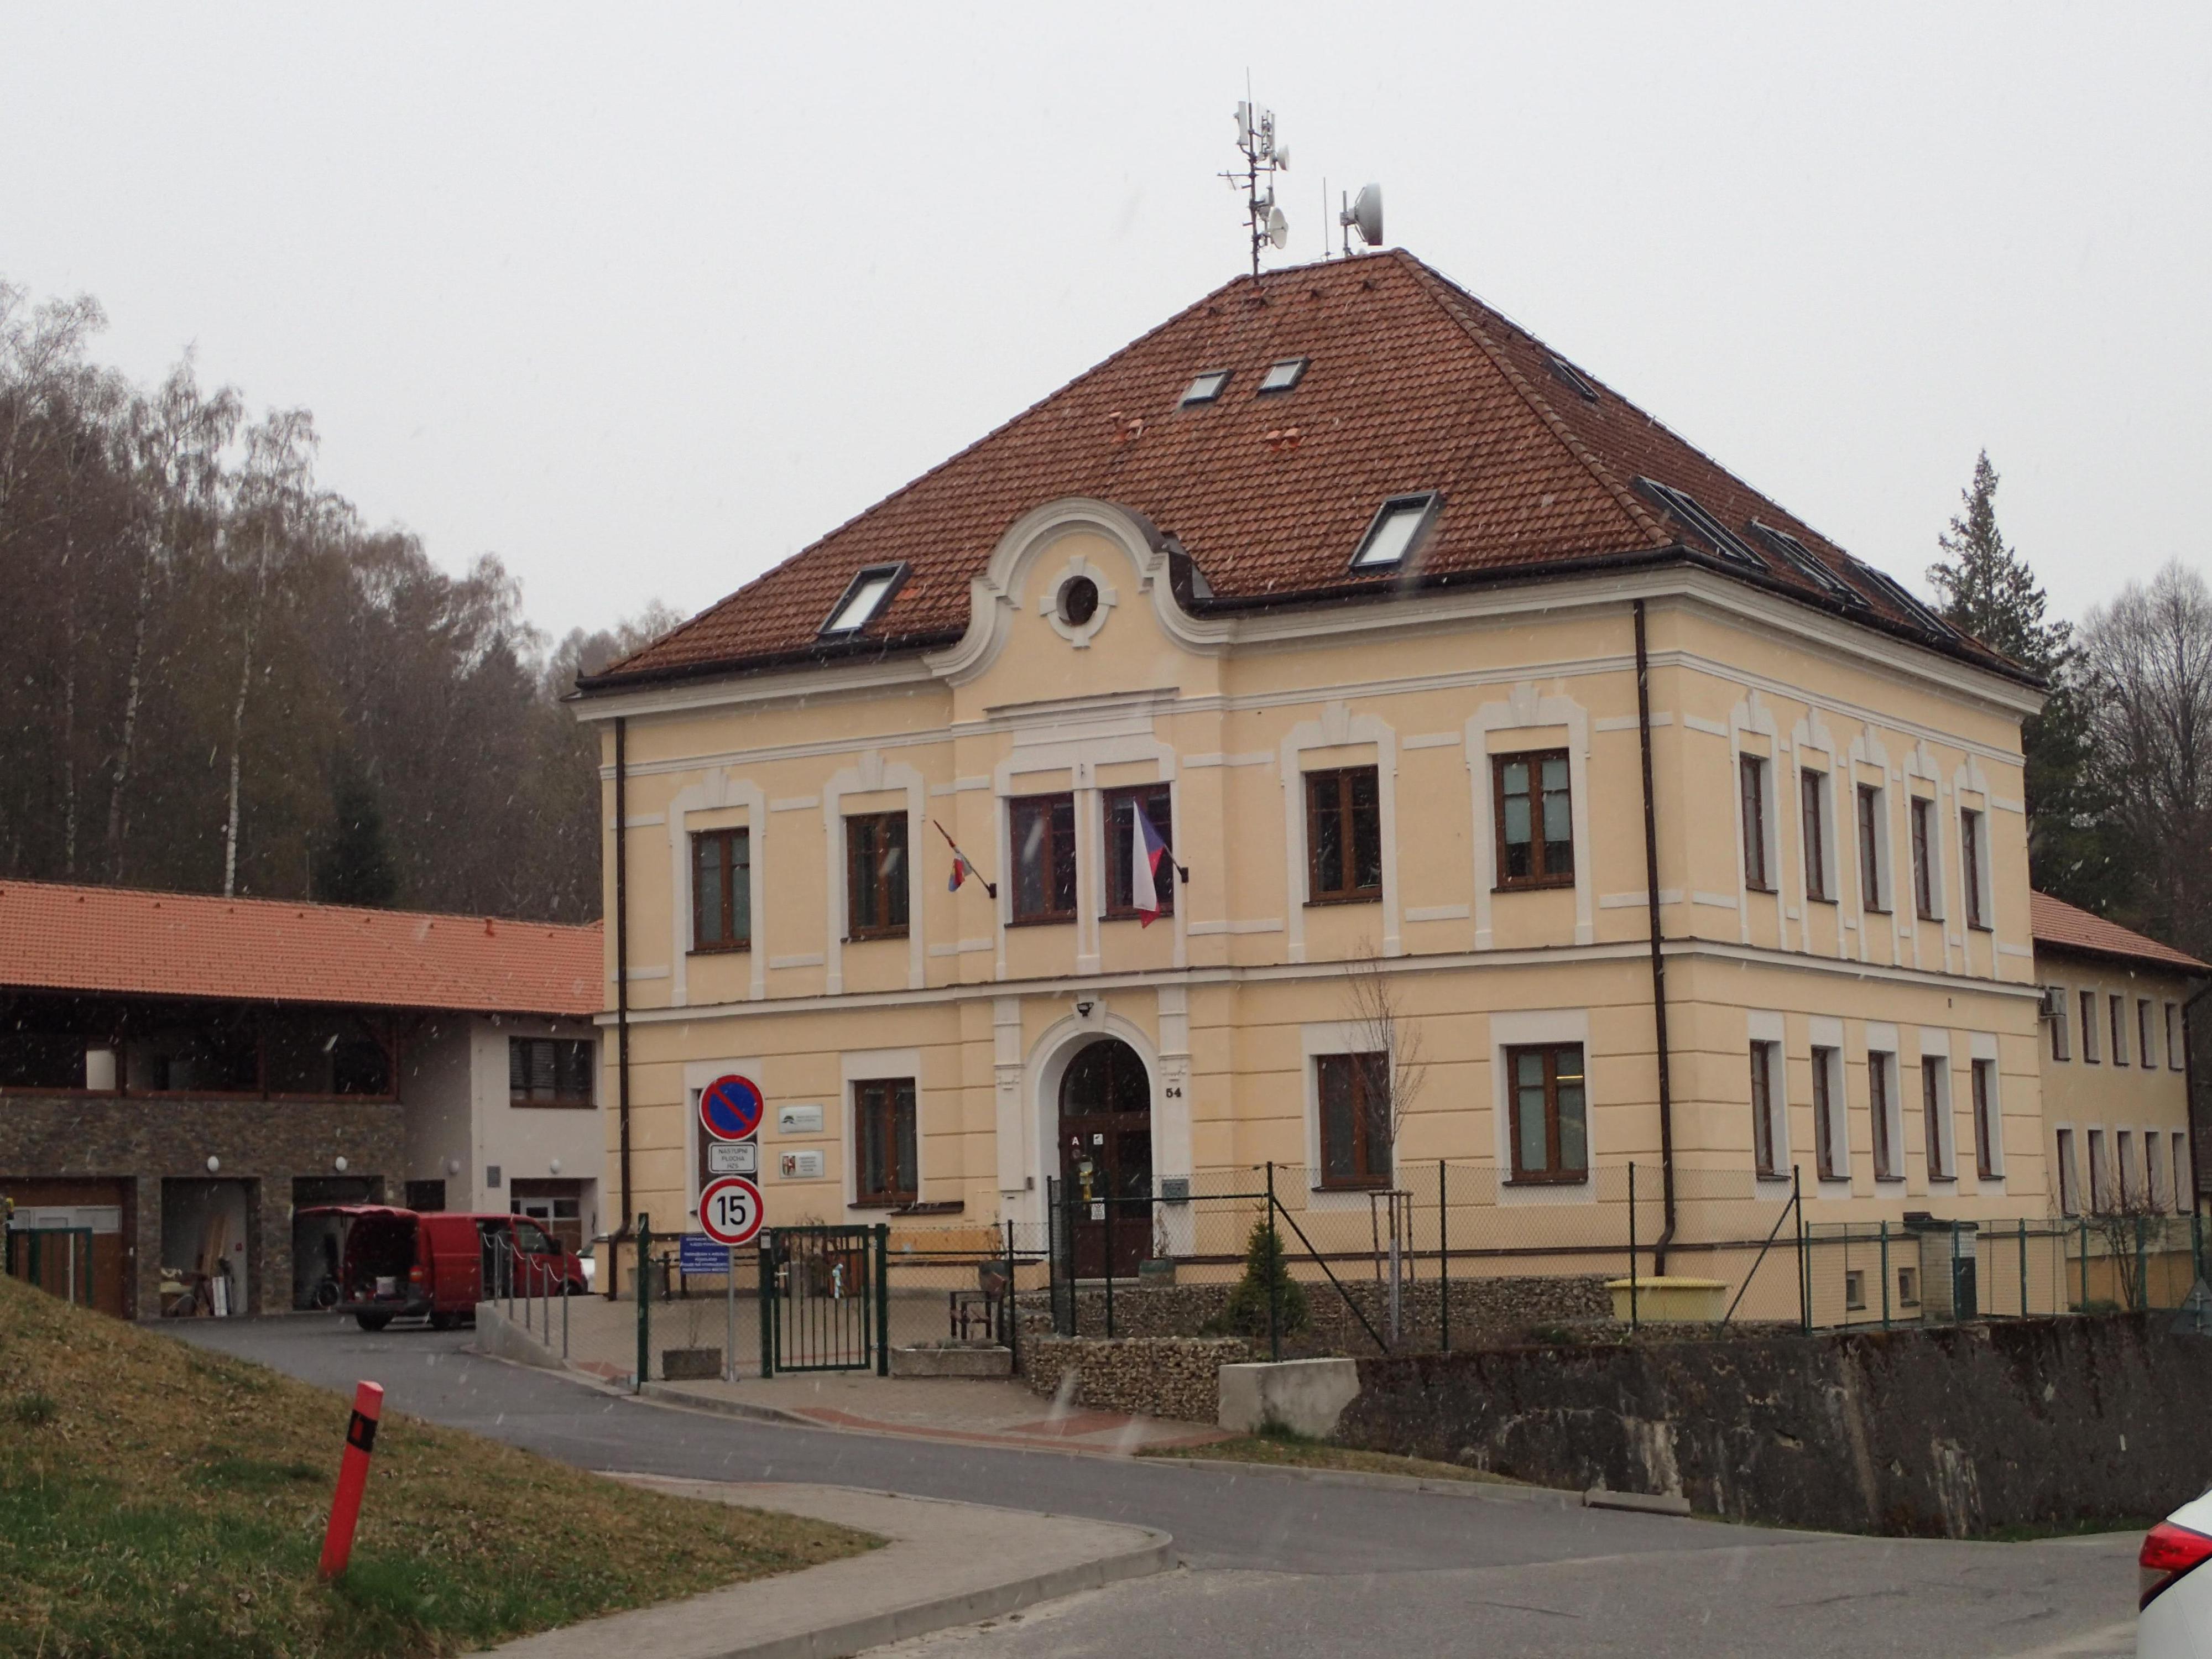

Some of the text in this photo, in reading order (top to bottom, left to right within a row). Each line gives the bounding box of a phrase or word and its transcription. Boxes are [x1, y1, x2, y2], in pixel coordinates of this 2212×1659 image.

[1166, 1087, 1182, 1098] 54
[1072, 1136, 1079, 1145] A
[717, 1196, 745, 1225] 15
